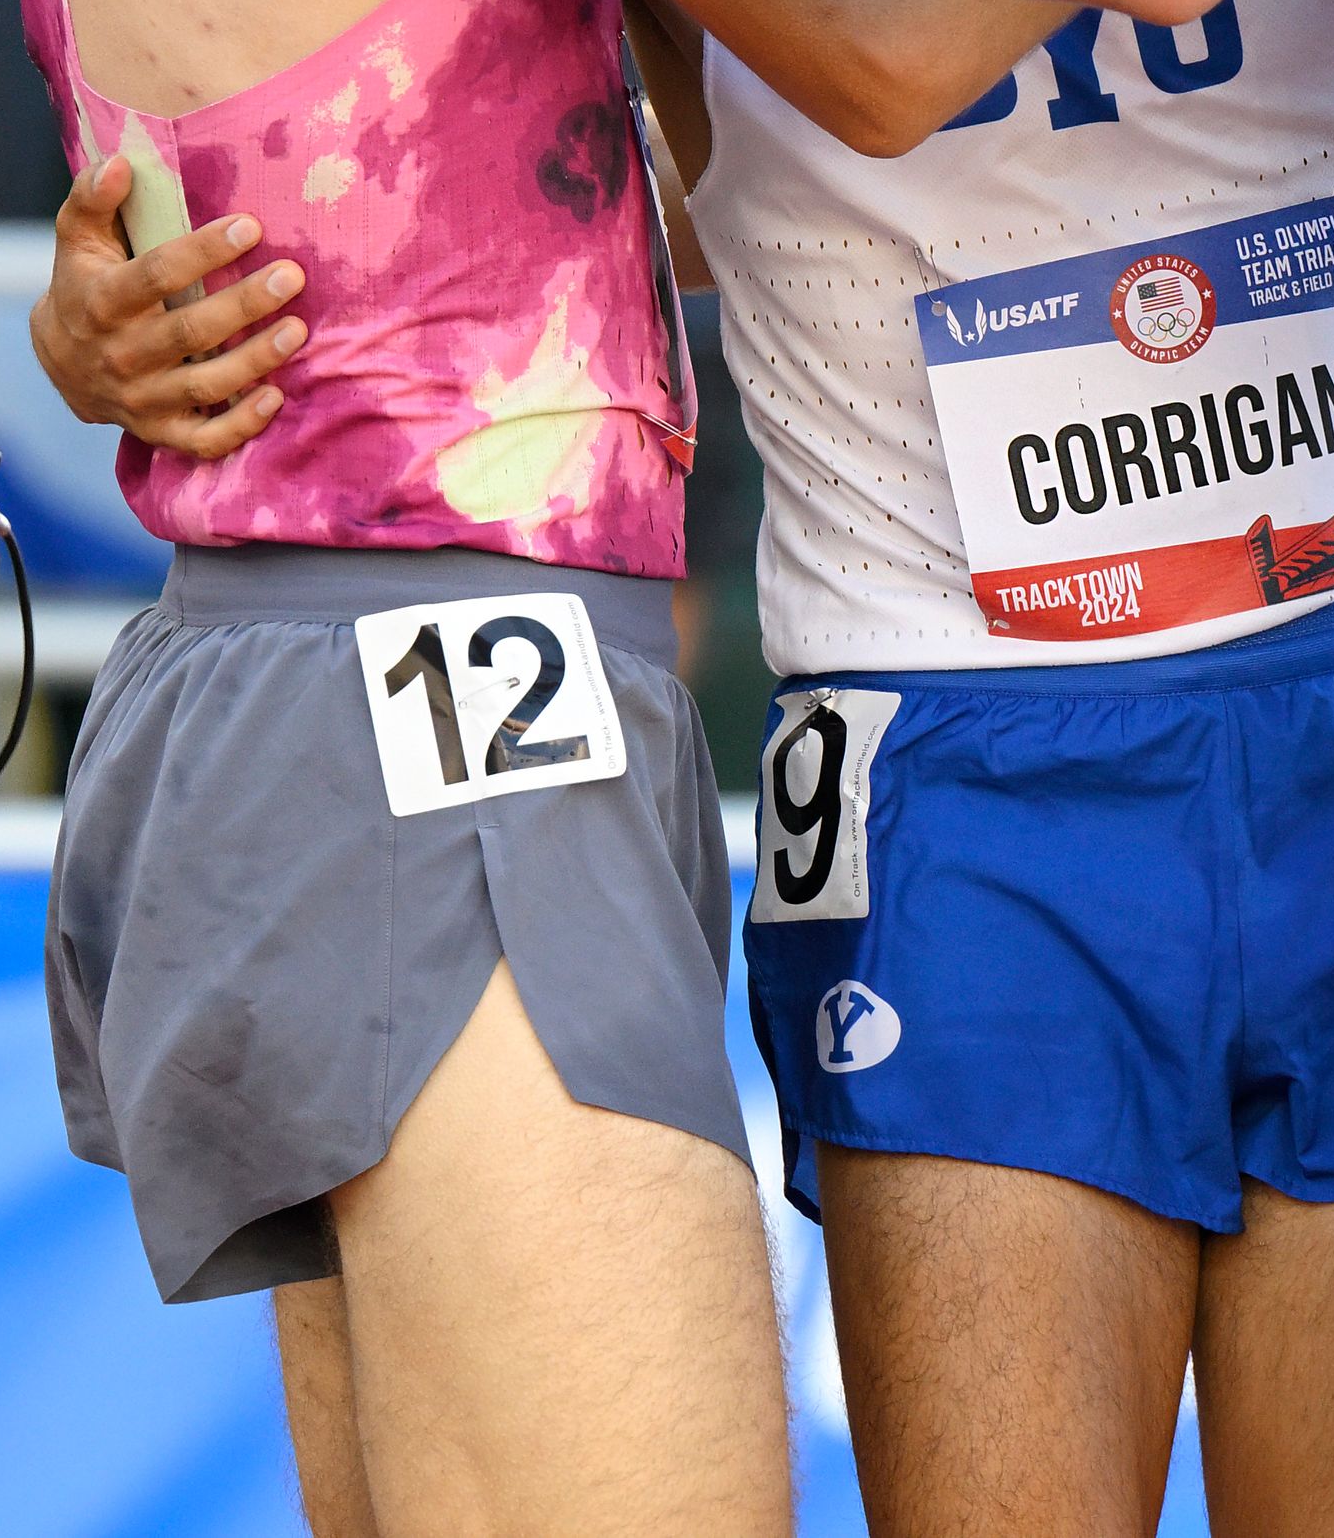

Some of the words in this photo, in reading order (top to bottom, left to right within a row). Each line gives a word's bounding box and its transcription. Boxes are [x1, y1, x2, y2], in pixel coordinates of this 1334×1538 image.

[1236, 233, 1273, 260] U.S.
[1117, 259, 1152, 293] UNITED
[1157, 257, 1199, 278] STATES
[1241, 254, 1292, 287] TEAM
[1249, 283, 1290, 307] TRACK
[1291, 280, 1301, 297] &
[1303, 272, 1333, 294] FIELD
[988, 291, 1082, 332] USATF
[1130, 340, 1179, 361] OLYMPIC
[1184, 326, 1209, 353] TEAM
[997, 560, 1143, 614] TRACKTOWN
[1078, 591, 1141, 628] 2024
[384, 615, 591, 786] 12
[602, 725, 612, 752] Track
[607, 754, 617, 770] On
[773, 703, 848, 905] 9
[853, 882, 861, 898] On
[825, 990, 876, 1063] Y
